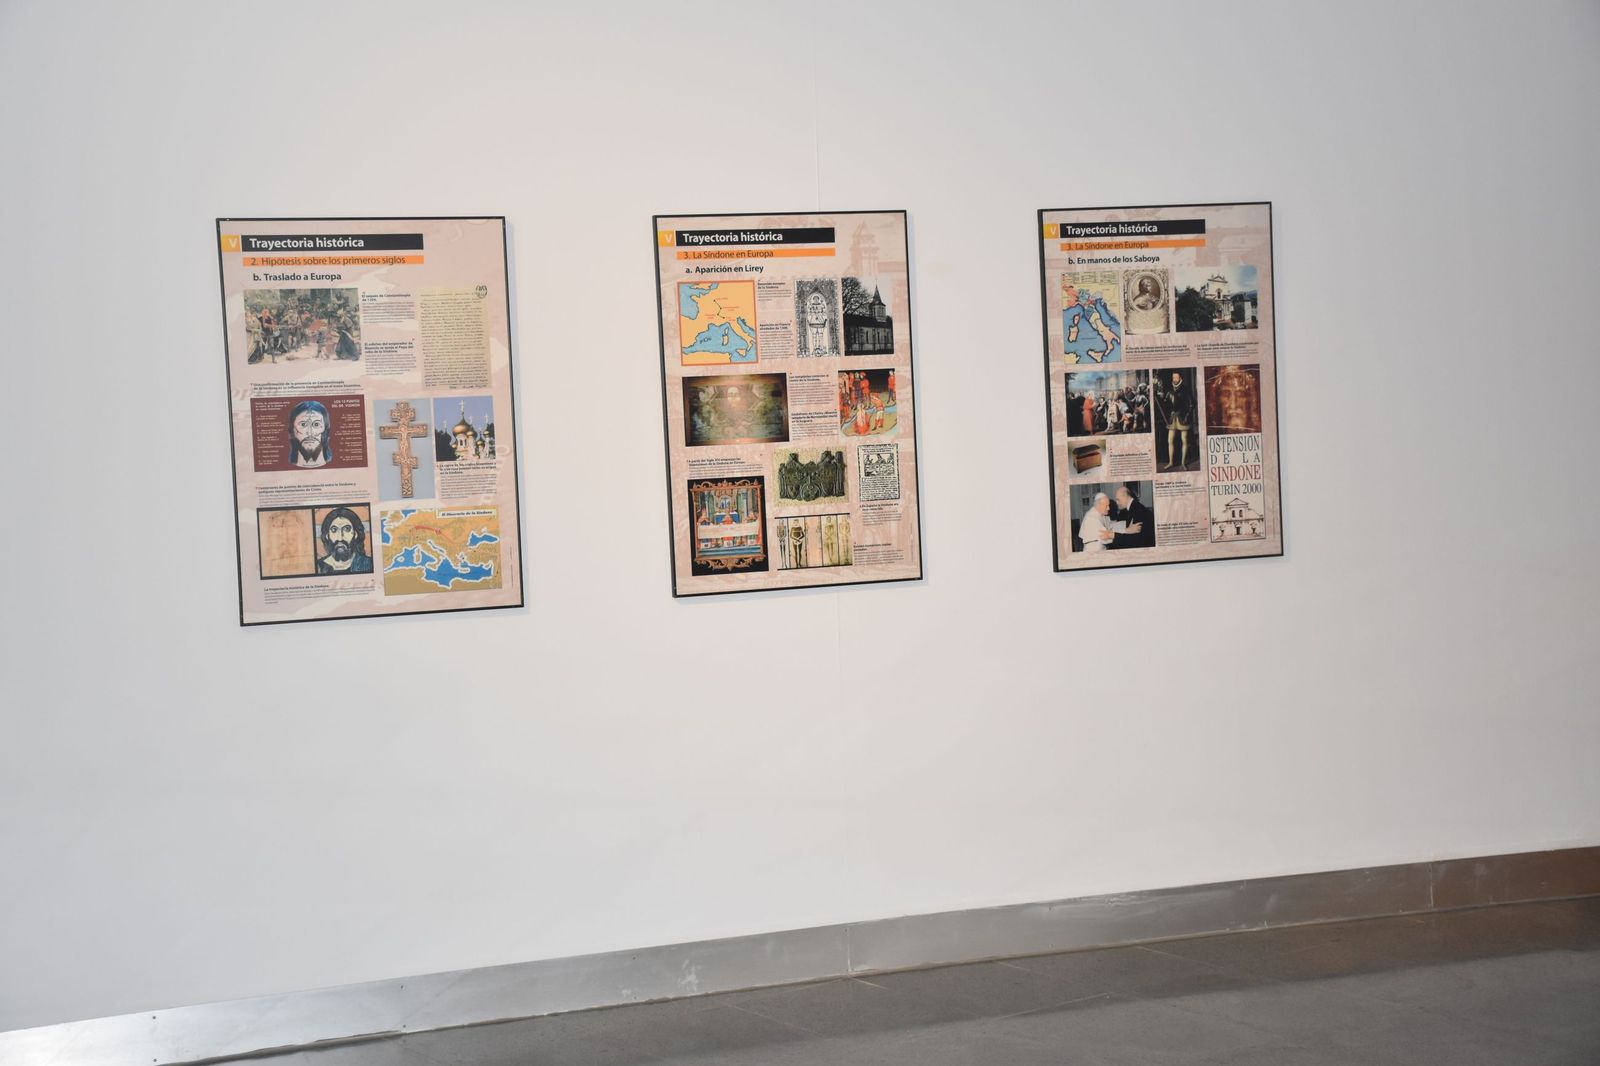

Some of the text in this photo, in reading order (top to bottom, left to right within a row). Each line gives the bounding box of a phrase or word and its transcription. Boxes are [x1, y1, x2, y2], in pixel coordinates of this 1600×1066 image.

[1066, 224, 1157, 236] Trayectoria histórica
[229, 238, 237, 248] V
[665, 235, 672, 243] V
[683, 232, 782, 244] Trayectoria histórica
[249, 237, 364, 250] Trayectoria histórica
[747, 250, 773, 259] Europa
[1134, 255, 1160, 263] Saboya
[251, 257, 260, 265] 2.
[303, 257, 327, 265] sobre
[329, 256, 341, 264] los
[343, 256, 380, 265] primeros
[382, 256, 406, 265] siglos
[695, 266, 732, 274] Aparición
[745, 265, 764, 273] Lirey
[310, 273, 342, 282] Europa
[1209, 435, 1260, 453] OSTENSION
[1211, 464, 1260, 482] SINDONE
[1242, 483, 1262, 494] 2000
